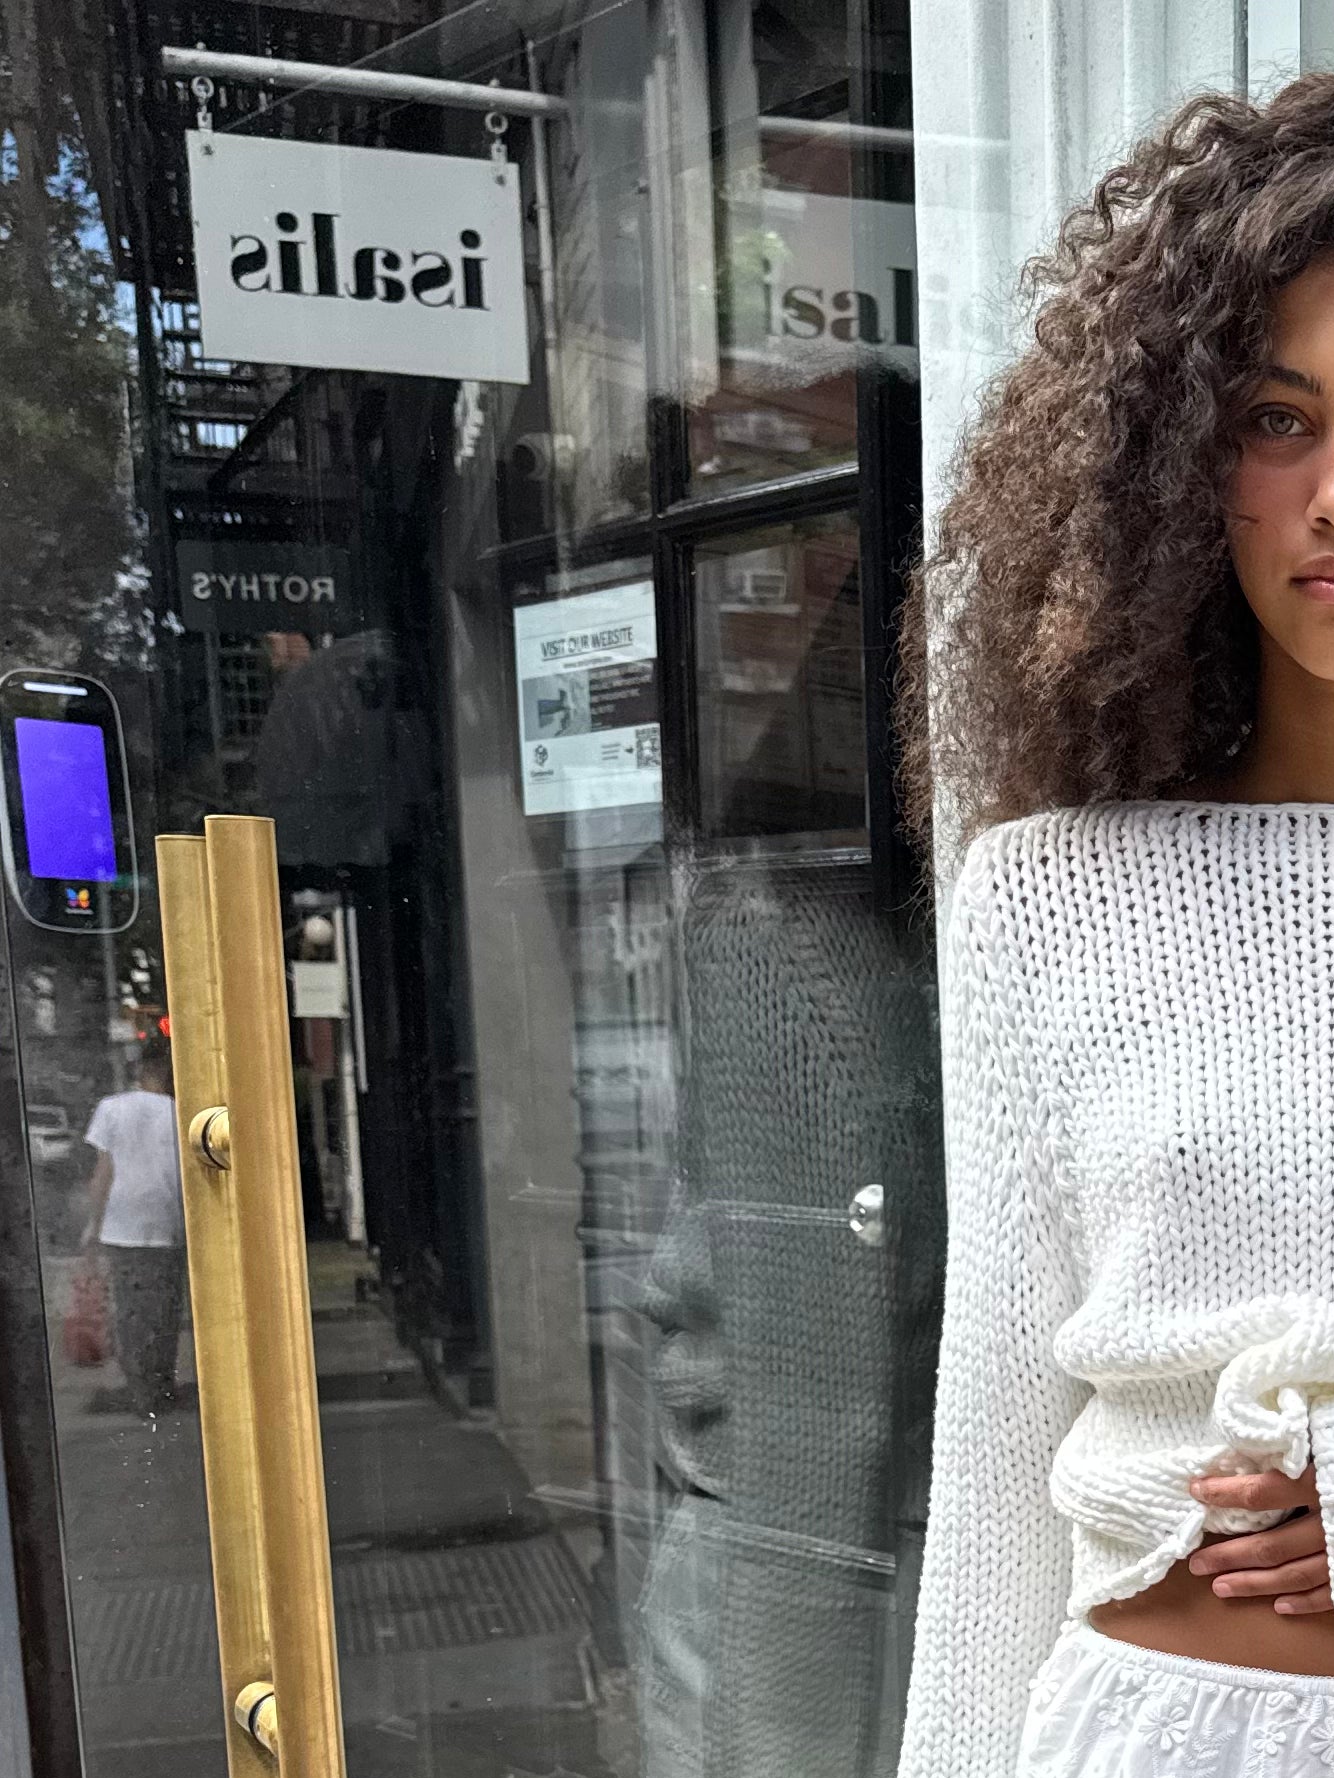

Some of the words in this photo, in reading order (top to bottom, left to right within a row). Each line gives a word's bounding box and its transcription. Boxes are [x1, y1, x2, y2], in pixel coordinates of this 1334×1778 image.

[541, 638, 566, 658] VISIT
[567, 634, 590, 653] OUR
[591, 626, 633, 649] WEBSITE
